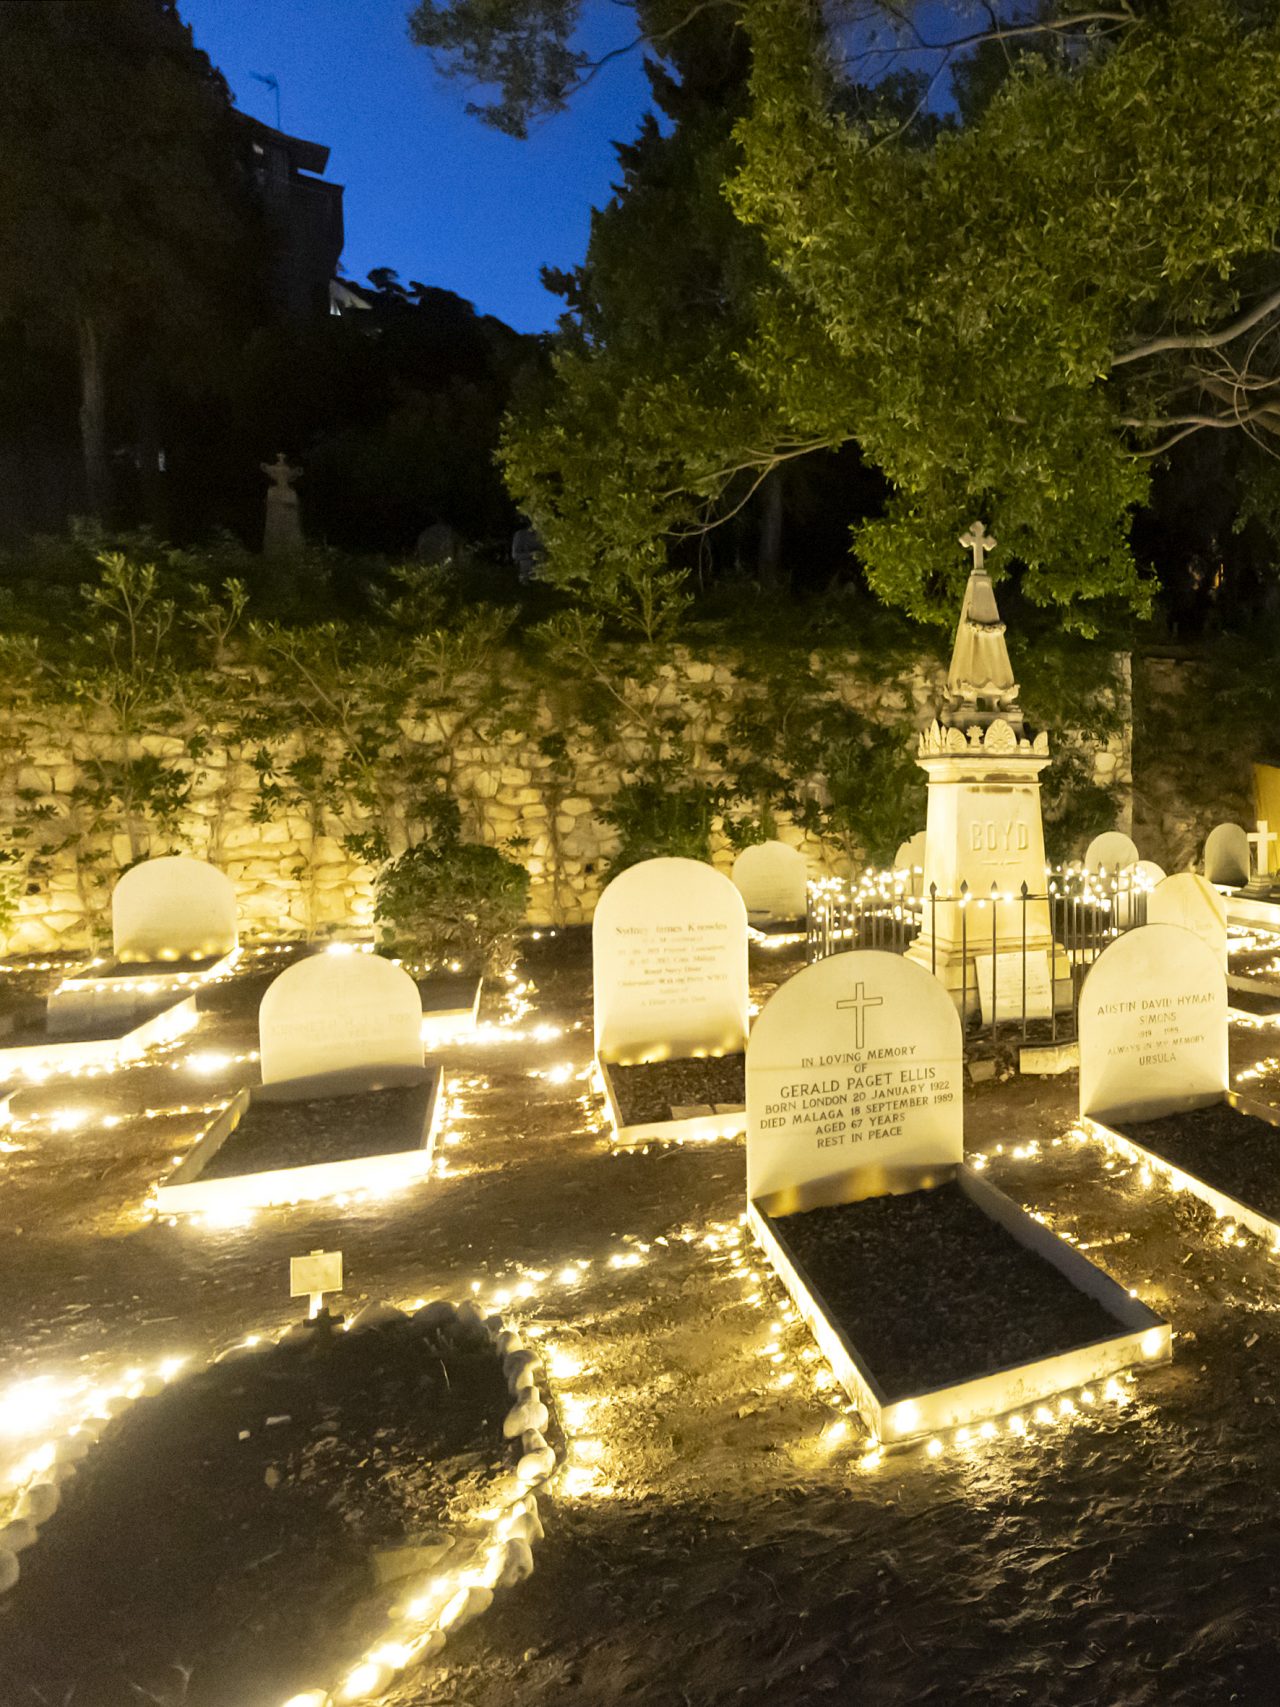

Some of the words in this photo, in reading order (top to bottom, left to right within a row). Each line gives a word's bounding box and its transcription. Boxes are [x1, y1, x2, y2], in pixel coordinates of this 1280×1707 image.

[970, 821, 1029, 851] BOYD
[1097, 1000, 1136, 1016] AUSTIN
[1141, 998, 1172, 1010] DAVID
[1177, 992, 1215, 1006] HYMAN
[1138, 1011, 1177, 1025] SIMONS
[801, 1057, 814, 1068] IN
[819, 1052, 862, 1066] LOVING
[867, 1045, 917, 1060] MEMORY
[854, 1062, 867, 1074] OF
[1138, 1052, 1177, 1066] URSULA
[780, 1080, 840, 1099] GERALD
[847, 1073, 893, 1090] PAGET
[900, 1067, 936, 1081] ELLIS
[765, 1102, 796, 1115] BORN
[802, 1094, 848, 1110] LONDON
[853, 1092, 866, 1102] 20
[871, 1084, 925, 1100] JANUARY
[930, 1080, 949, 1091] 1922
[760, 1117, 786, 1130] DIED
[792, 1110, 843, 1125] MALAGA
[850, 1106, 861, 1116] 18
[866, 1096, 929, 1114] SEPTEMBER
[934, 1092, 954, 1104] 1989
[815, 1122, 846, 1135] AGED
[851, 1119, 863, 1128] 67
[869, 1112, 906, 1127] YEARS
[817, 1136, 845, 1149] REST
[851, 1133, 863, 1143] IN
[868, 1126, 903, 1140] PEACE
